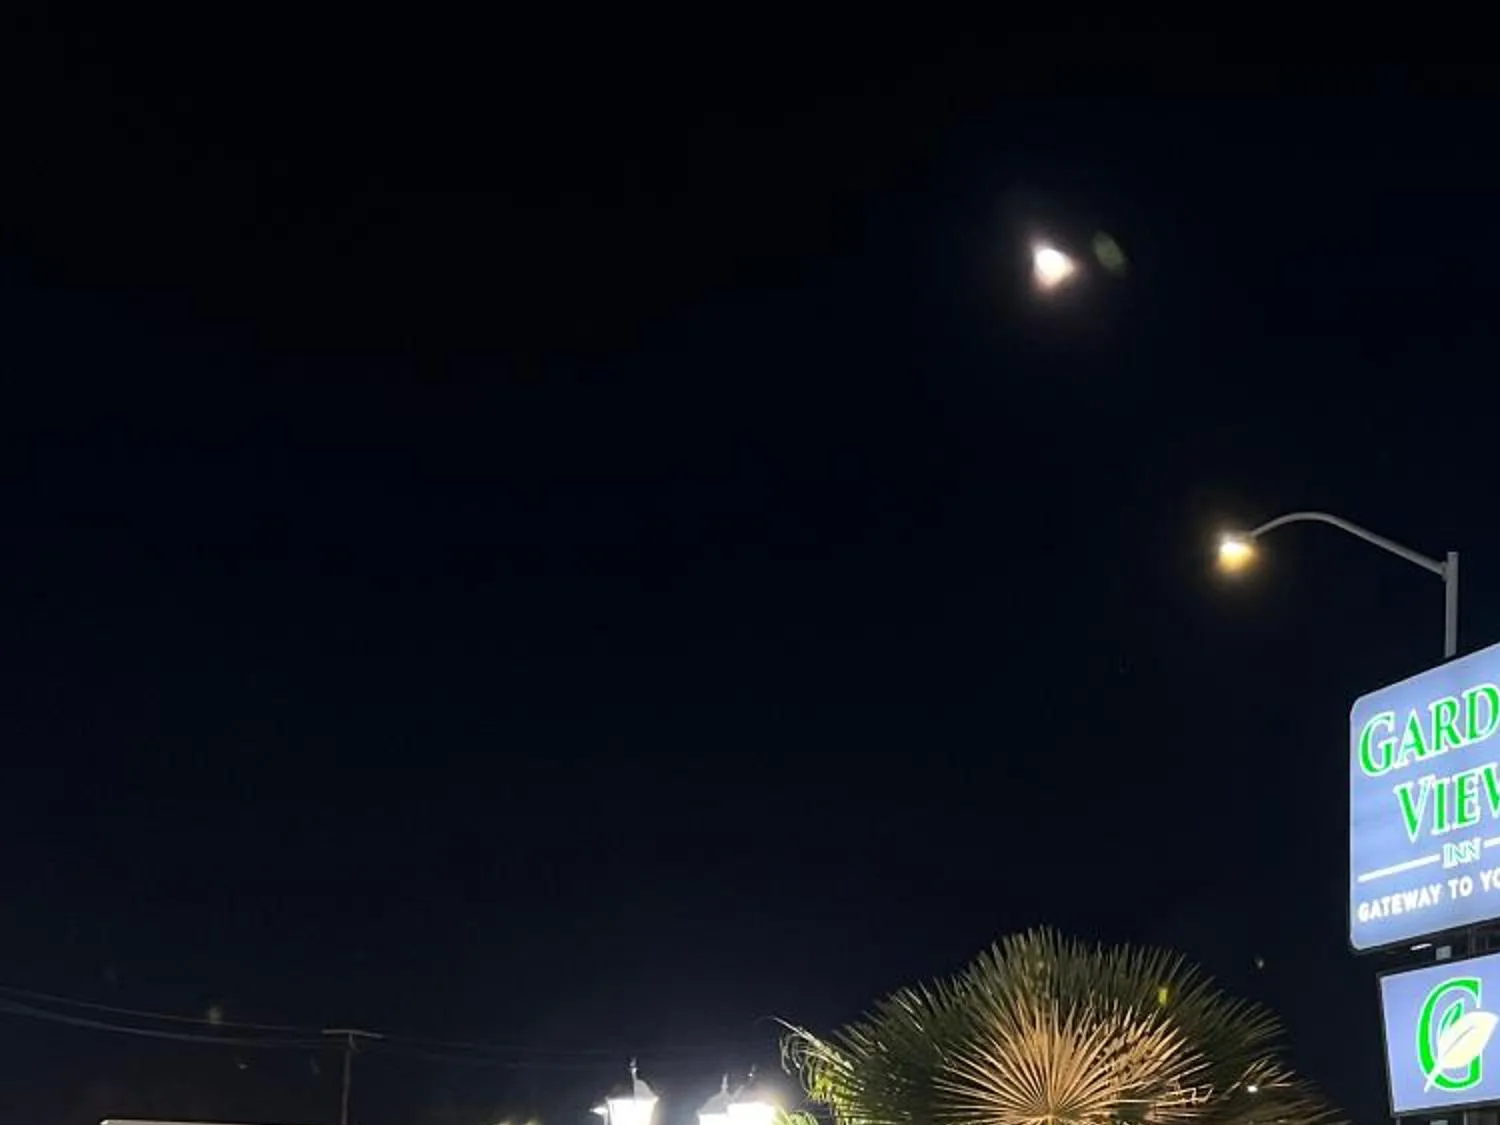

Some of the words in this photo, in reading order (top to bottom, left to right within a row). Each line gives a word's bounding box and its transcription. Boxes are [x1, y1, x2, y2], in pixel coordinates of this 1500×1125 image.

[1442, 837, 1481, 870] INN
[1357, 883, 1442, 922] GATEWAY
[1448, 877, 1474, 900] TO
